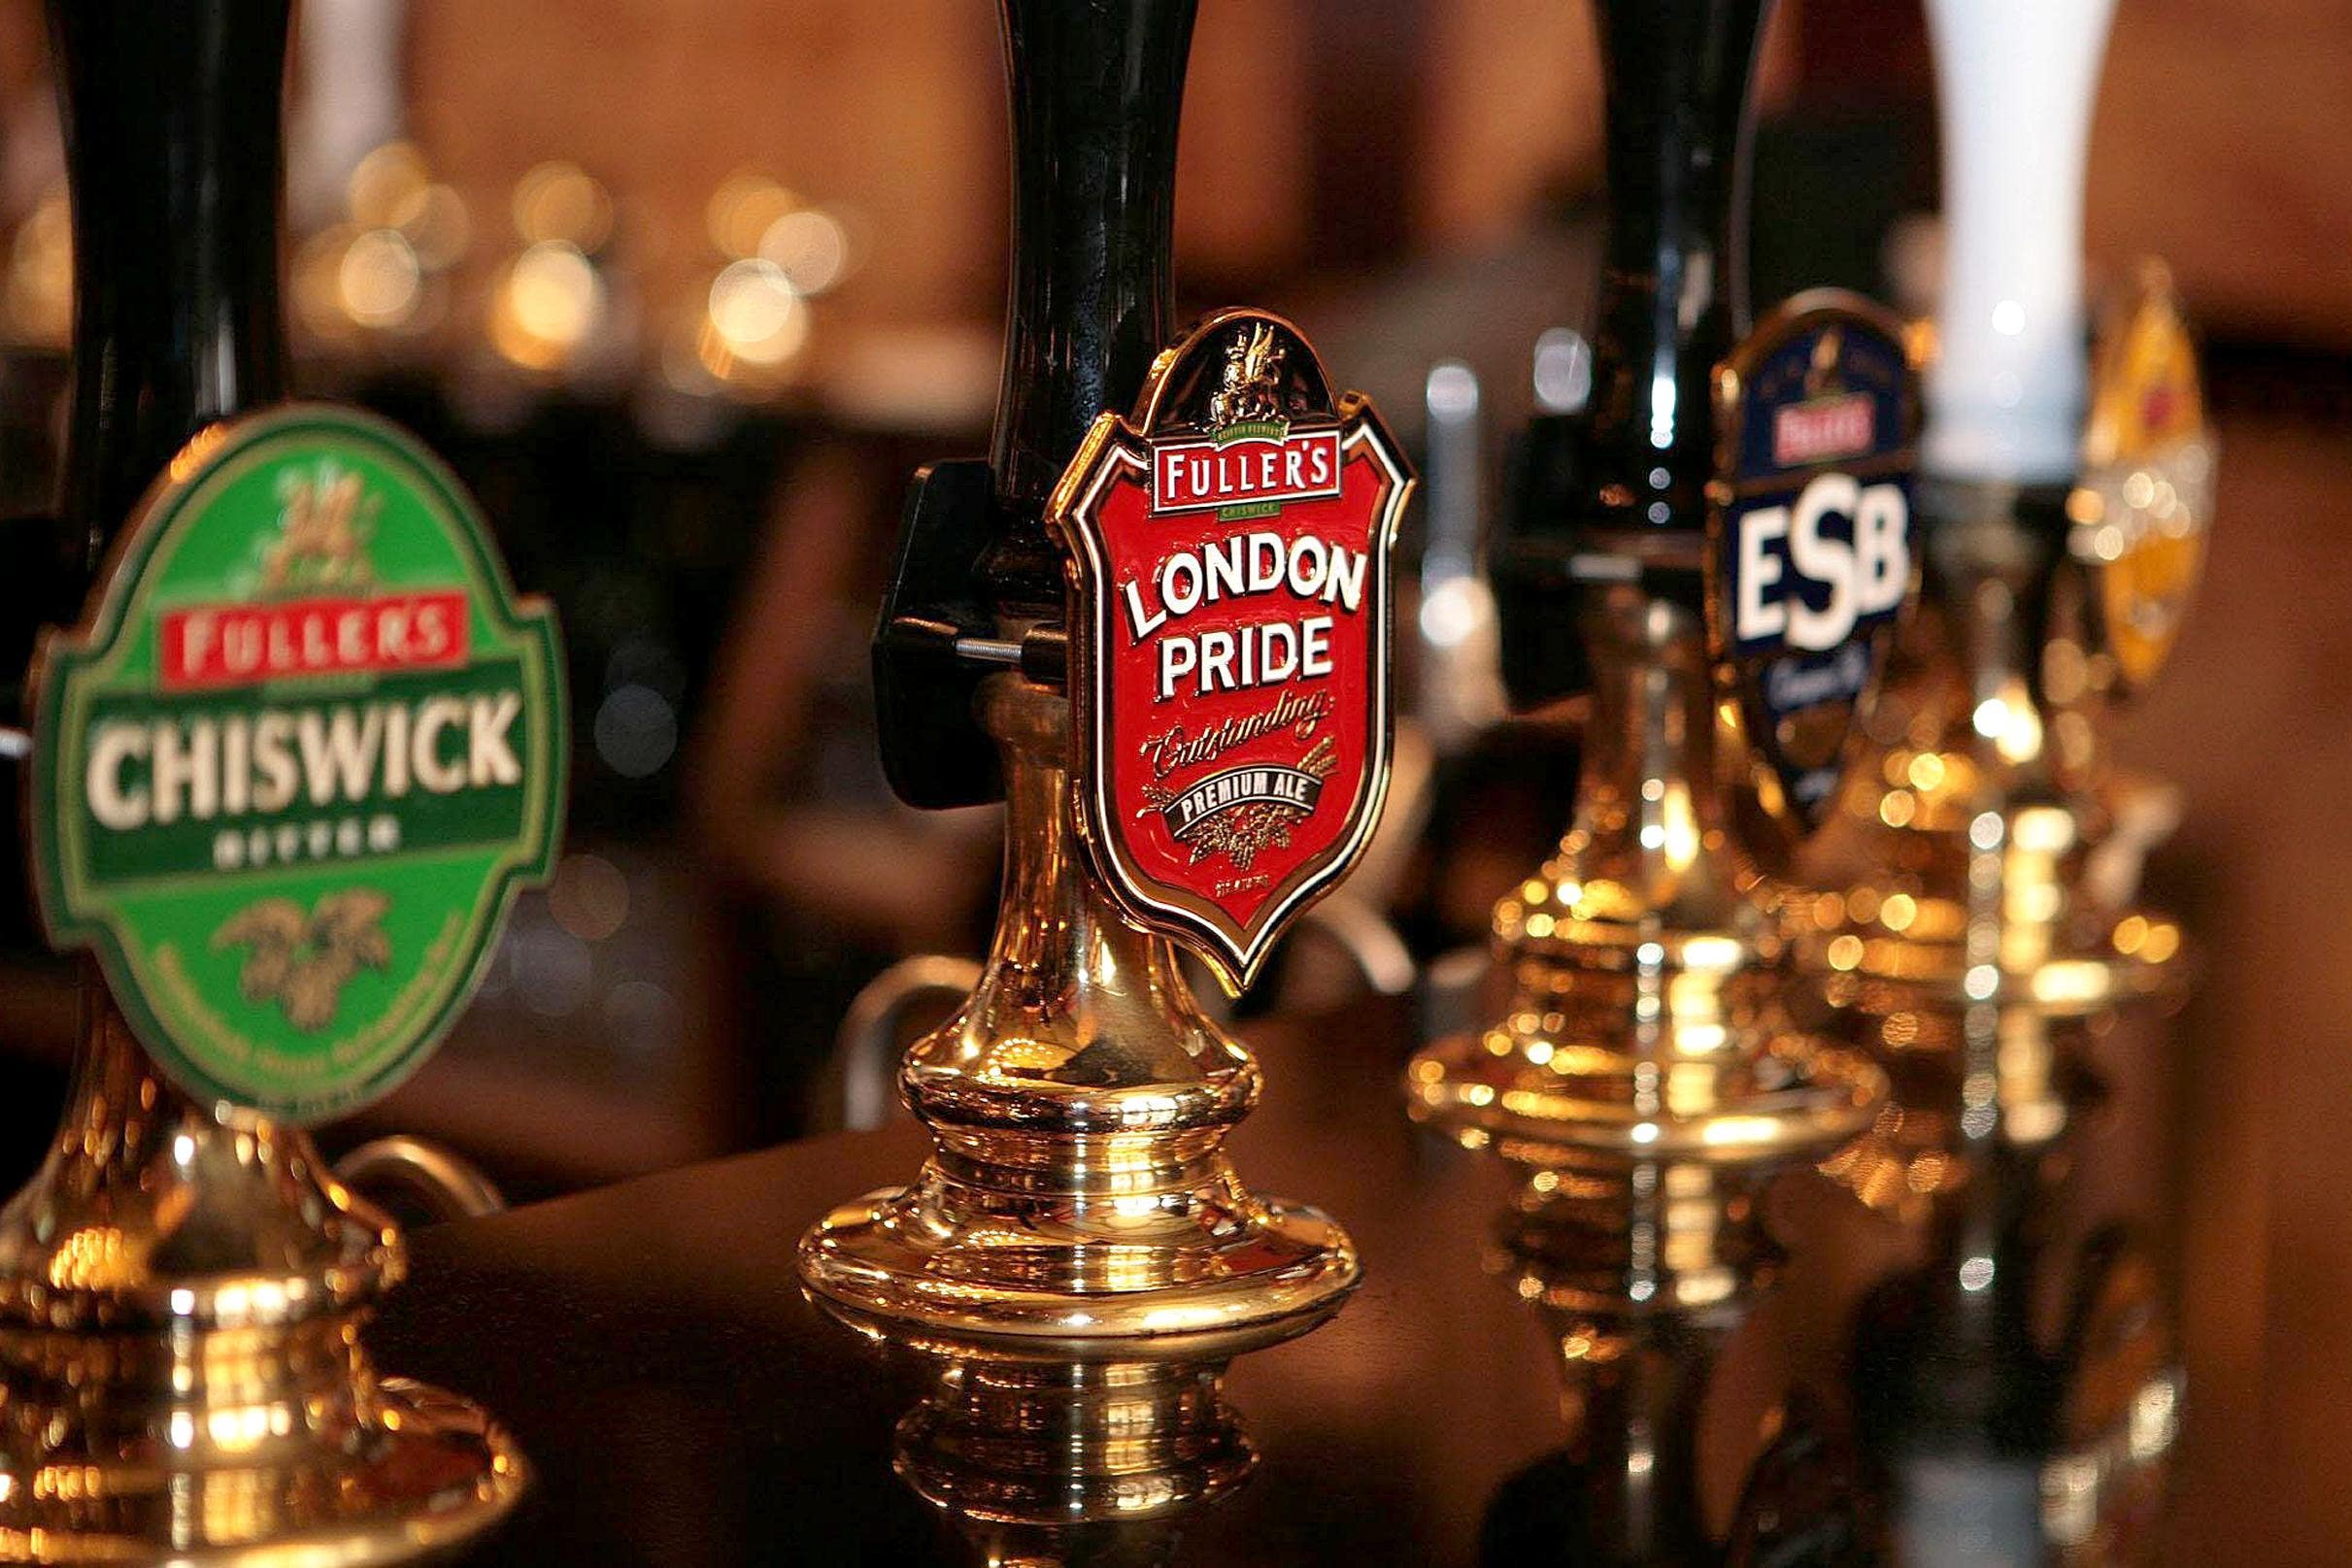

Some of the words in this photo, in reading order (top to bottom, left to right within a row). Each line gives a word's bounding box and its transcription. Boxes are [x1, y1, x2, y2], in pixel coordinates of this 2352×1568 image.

[1166, 440, 1329, 499] FULLER'S
[1124, 532, 1367, 639] LONDON
[1736, 472, 1911, 652] ESB
[1159, 615, 1334, 698] PRIDE
[86, 690, 522, 832] CHISWICK
[1137, 688, 1335, 779] Outstanding
[1180, 772, 1269, 823] PREMIUM
[1273, 774, 1309, 802] ALE
